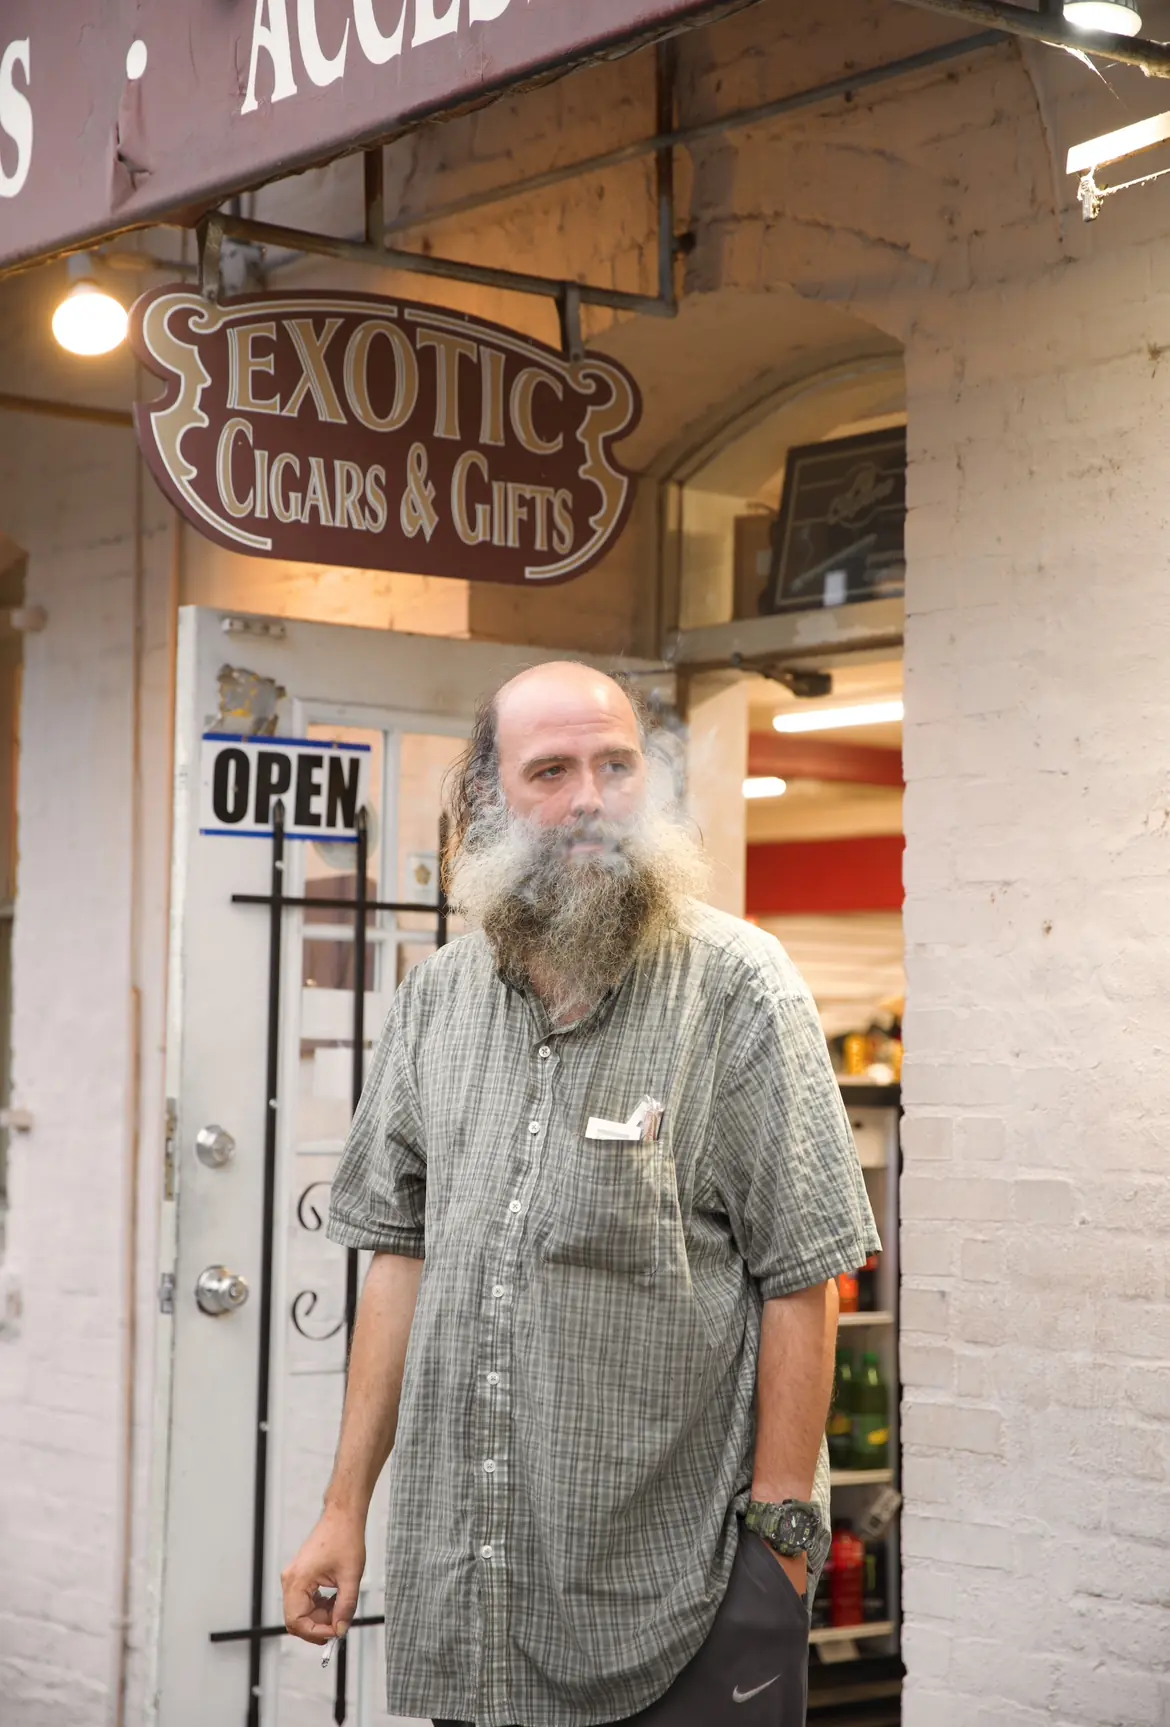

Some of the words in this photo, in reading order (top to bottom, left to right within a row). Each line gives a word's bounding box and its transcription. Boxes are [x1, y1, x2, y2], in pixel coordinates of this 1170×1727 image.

[226, 317, 564, 456] EXOTIC
[215, 417, 388, 534] CIGARS
[399, 441, 439, 543] &
[450, 449, 575, 556] GIFTS
[212, 747, 361, 829] OPEN
